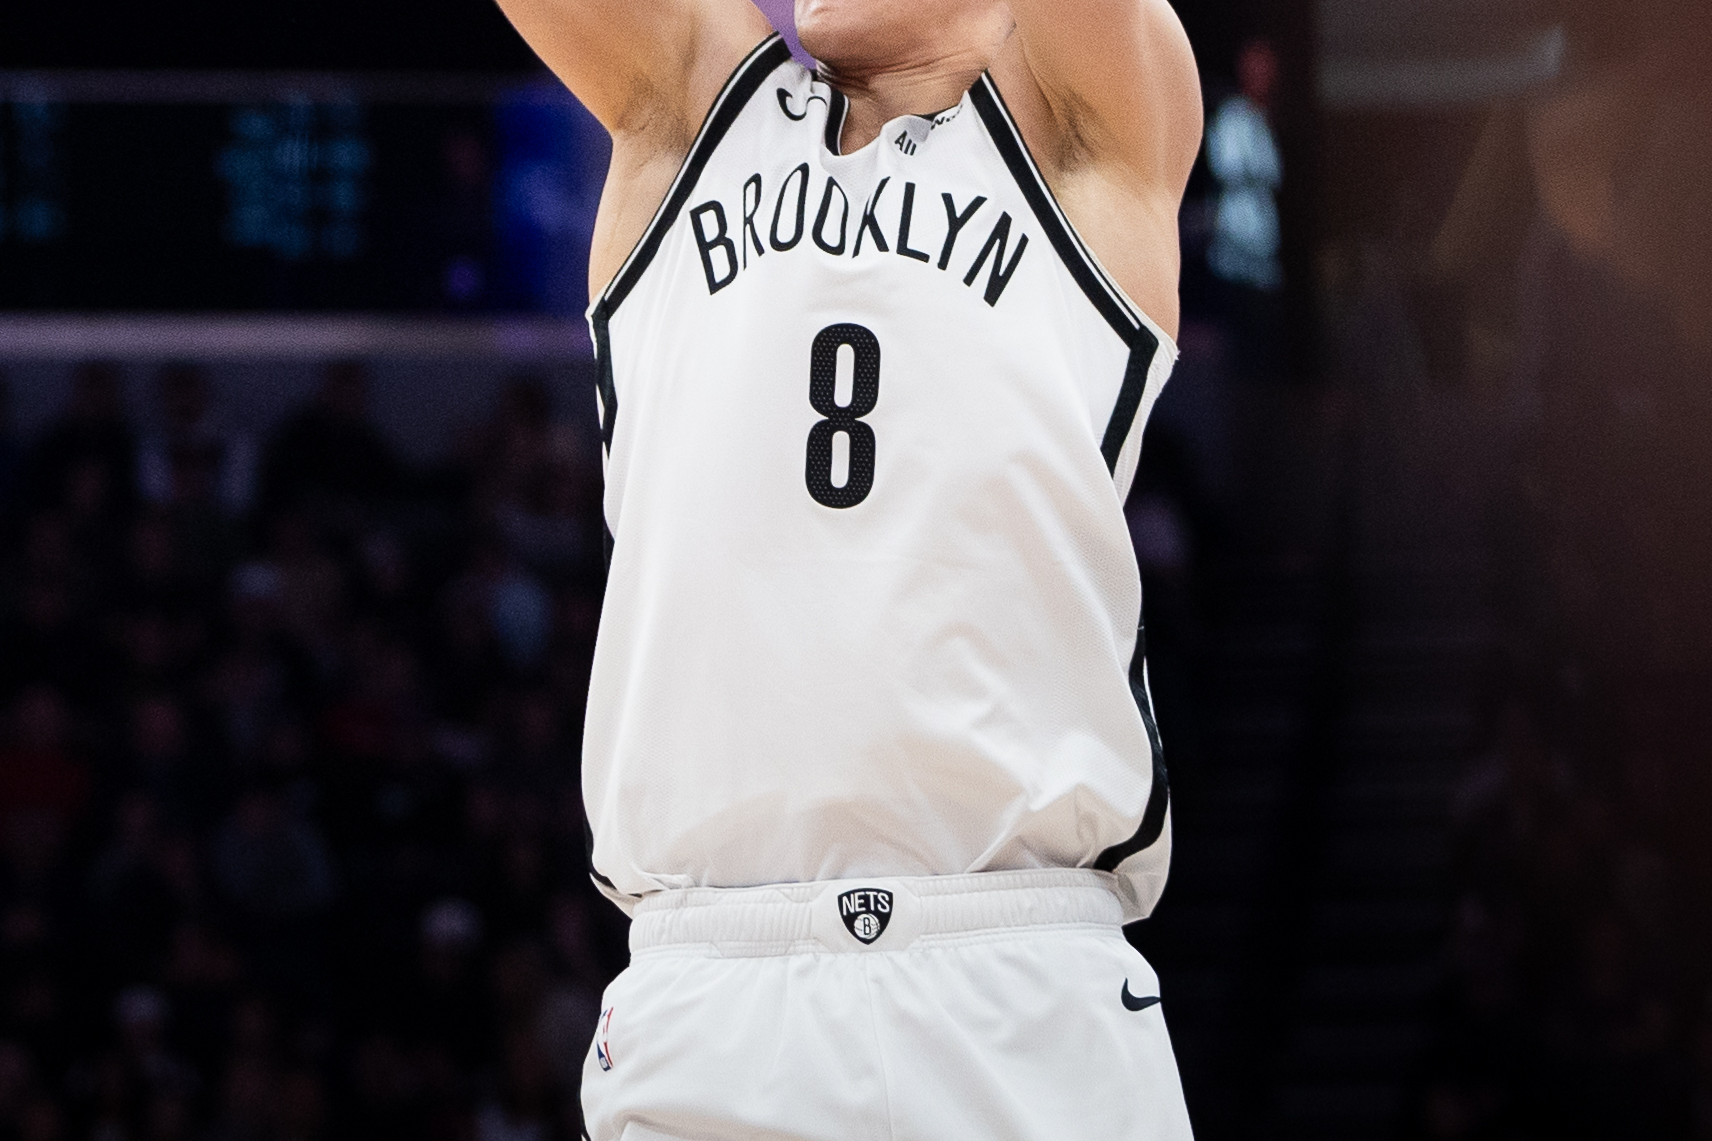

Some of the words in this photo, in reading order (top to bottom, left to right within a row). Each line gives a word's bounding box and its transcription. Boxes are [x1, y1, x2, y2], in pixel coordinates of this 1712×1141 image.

[689, 163, 1029, 308] BROOKLYN
[805, 322, 882, 510] 8
[842, 891, 890, 916] NETS
